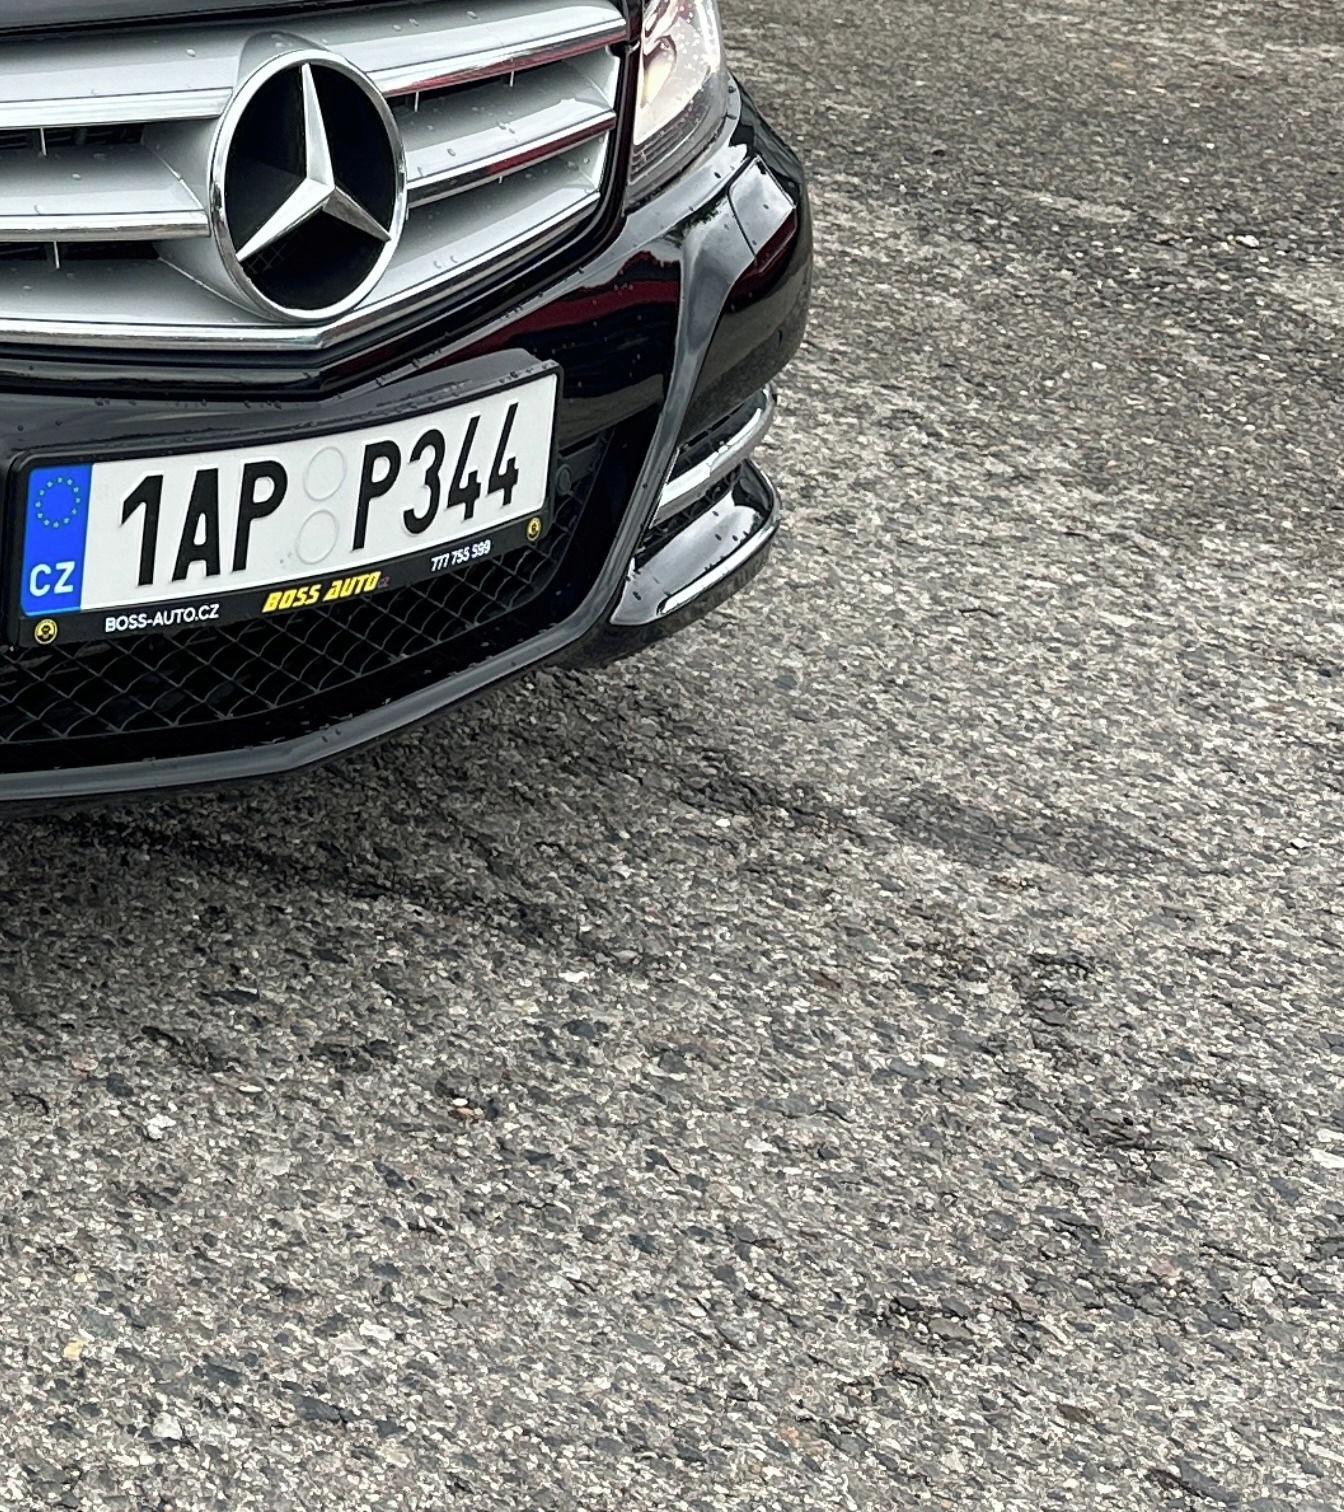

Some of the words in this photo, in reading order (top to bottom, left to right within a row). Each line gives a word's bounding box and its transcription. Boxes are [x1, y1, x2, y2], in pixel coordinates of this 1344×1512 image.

[120, 460, 289, 587] 1AP
[351, 402, 520, 552] P344
[431, 553, 450, 572] 777
[451, 546, 470, 565] 755
[29, 560, 75, 597] CZ
[262, 584, 322, 613] BOSS
[323, 571, 381, 601] AUTO
[105, 604, 220, 633] BOSS-AUTO.CZ
